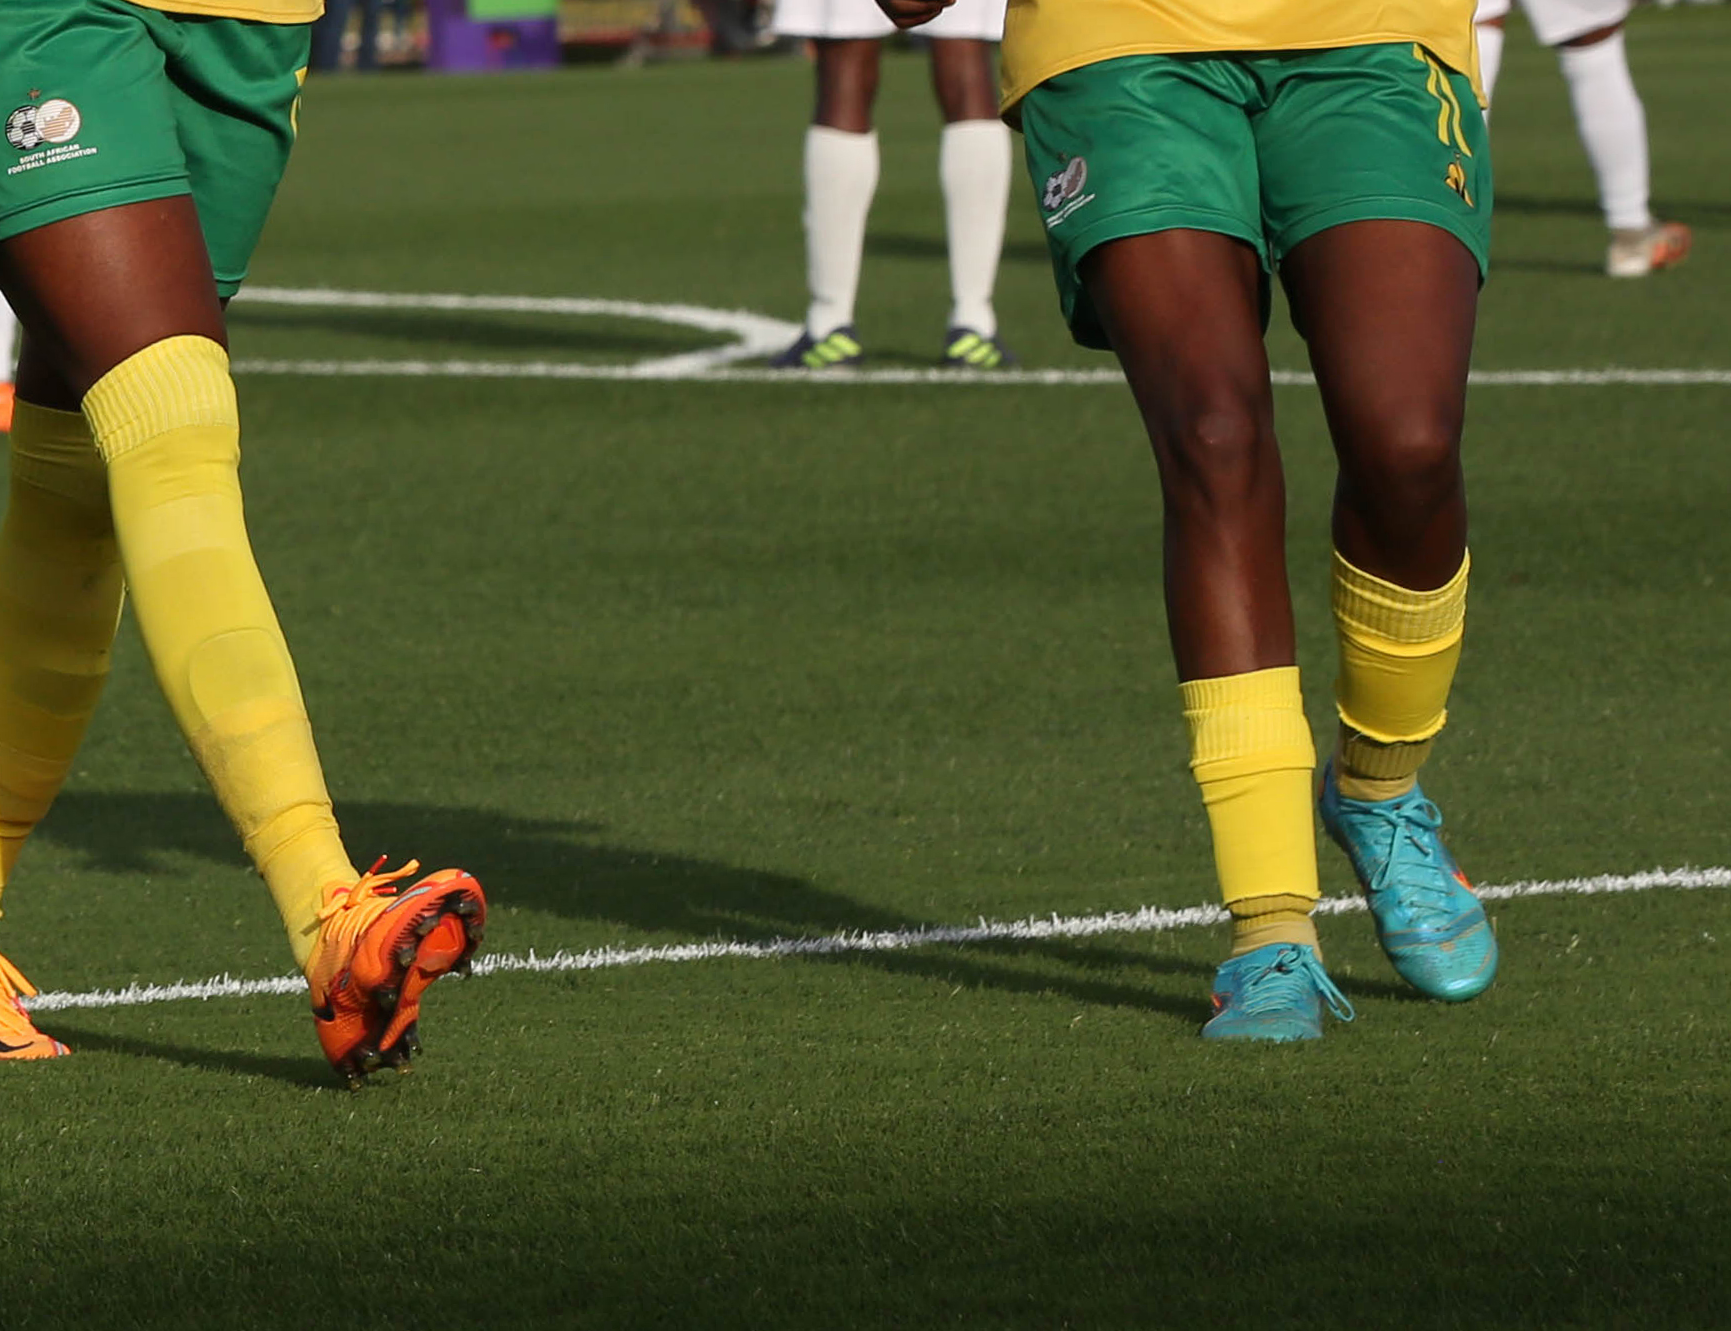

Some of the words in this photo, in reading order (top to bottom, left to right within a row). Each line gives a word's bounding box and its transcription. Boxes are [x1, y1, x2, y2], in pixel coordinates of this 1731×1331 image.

[7, 159, 46, 175] FOOTBALL
[46, 147, 98, 164] ASSOCIATION
[19, 151, 45, 165] SOUTH
[46, 143, 80, 157] AFRICAN
